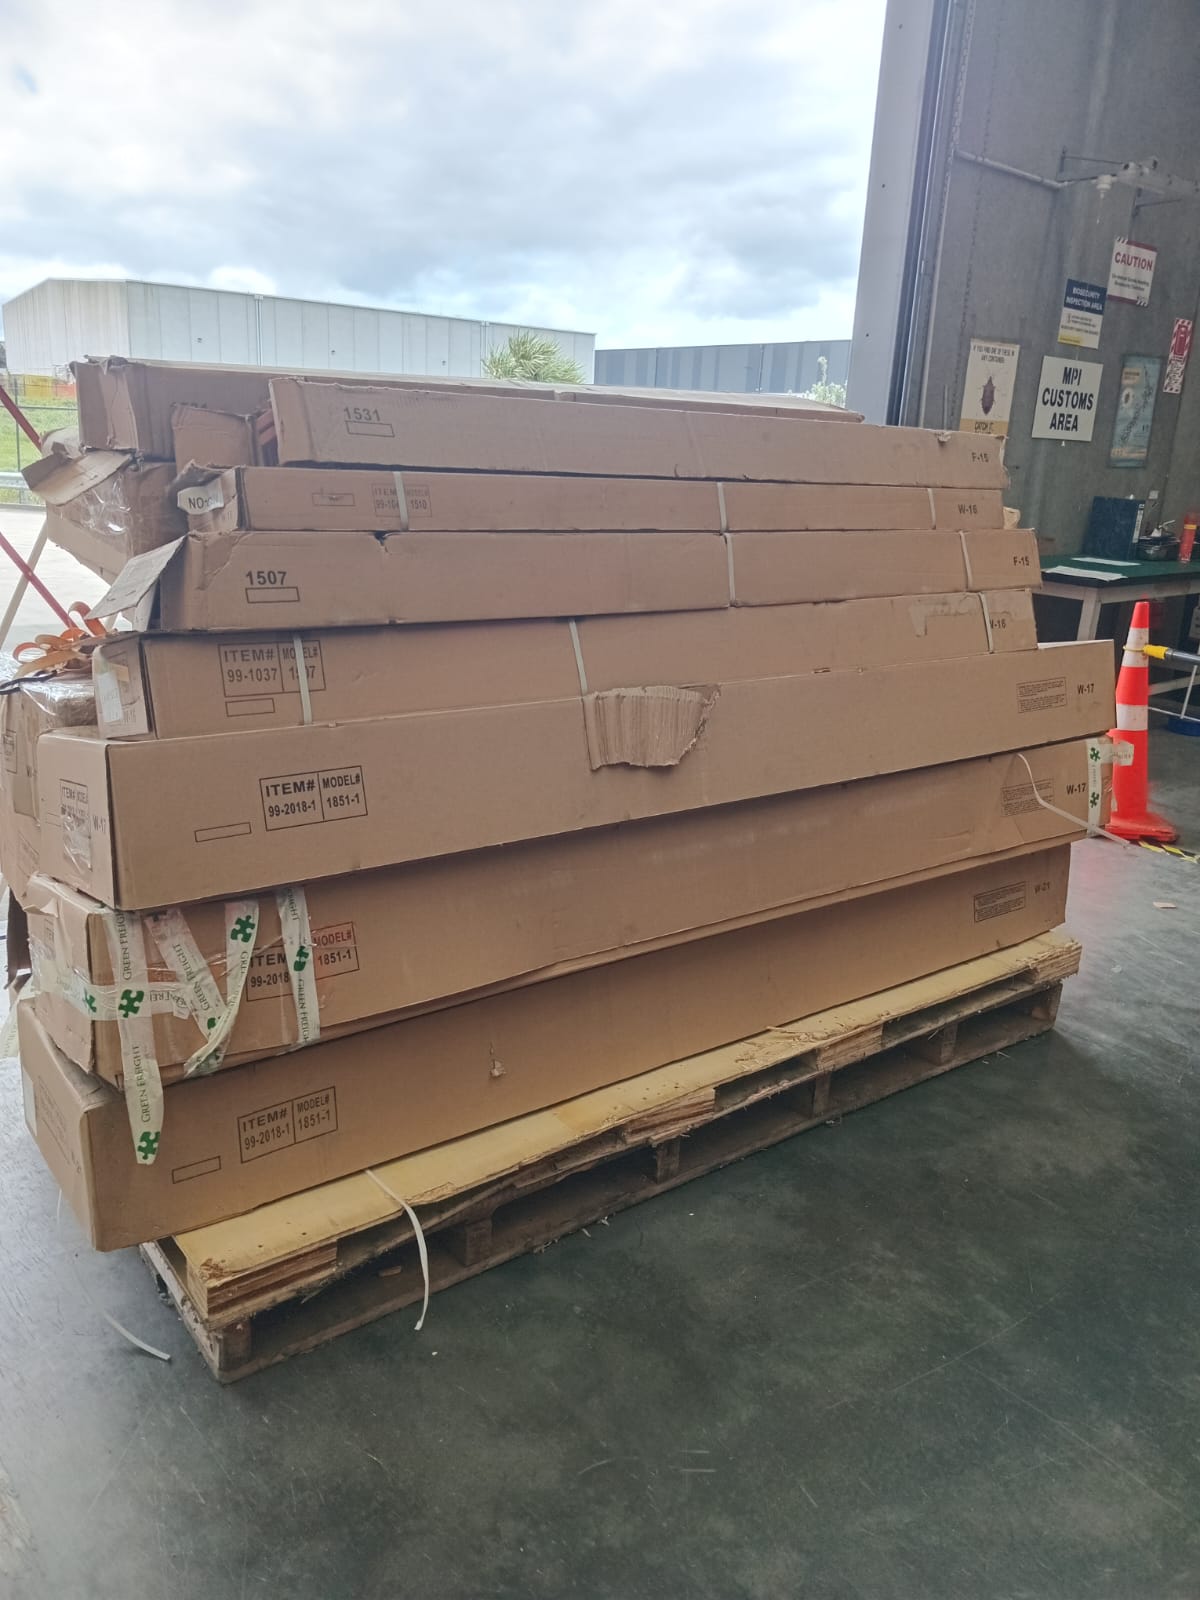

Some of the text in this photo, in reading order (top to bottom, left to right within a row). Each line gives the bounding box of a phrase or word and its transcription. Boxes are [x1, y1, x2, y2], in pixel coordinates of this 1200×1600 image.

[1114, 252, 1153, 271] CAUTION
[1062, 366, 1082, 386] MPI
[1042, 387, 1094, 411] CUSTOMS
[343, 407, 381, 422] 1531
[1049, 412, 1078, 432] AREA
[971, 452, 990, 463] F-15
[1013, 556, 1030, 567] F-15
[245, 570, 288, 586] 1507
[223, 646, 319, 663] ITEM# MOEL#
[227, 665, 316, 683] 99-1037 17
[1077, 683, 1095, 695] W-17
[265, 773, 361, 798] ITEM# MODEL#
[1066, 782, 1087, 795] W-17
[268, 792, 360, 818] 99-2018-1 1851-1
[120, 947, 133, 981] GREEN
[173, 943, 197, 982] FREIGHT
[250, 953, 287, 969] ITEM
[250, 949, 352, 988] 99-2018 1851-1
[193, 981, 211, 1011] GREEN
[297, 978, 307, 1010] GREEN
[131, 1045, 151, 1123] GREEN FREIGHT
[242, 1094, 330, 1133] ITEM# MODEL#
[244, 1109, 330, 1151] 99-2018-1 1851-1
